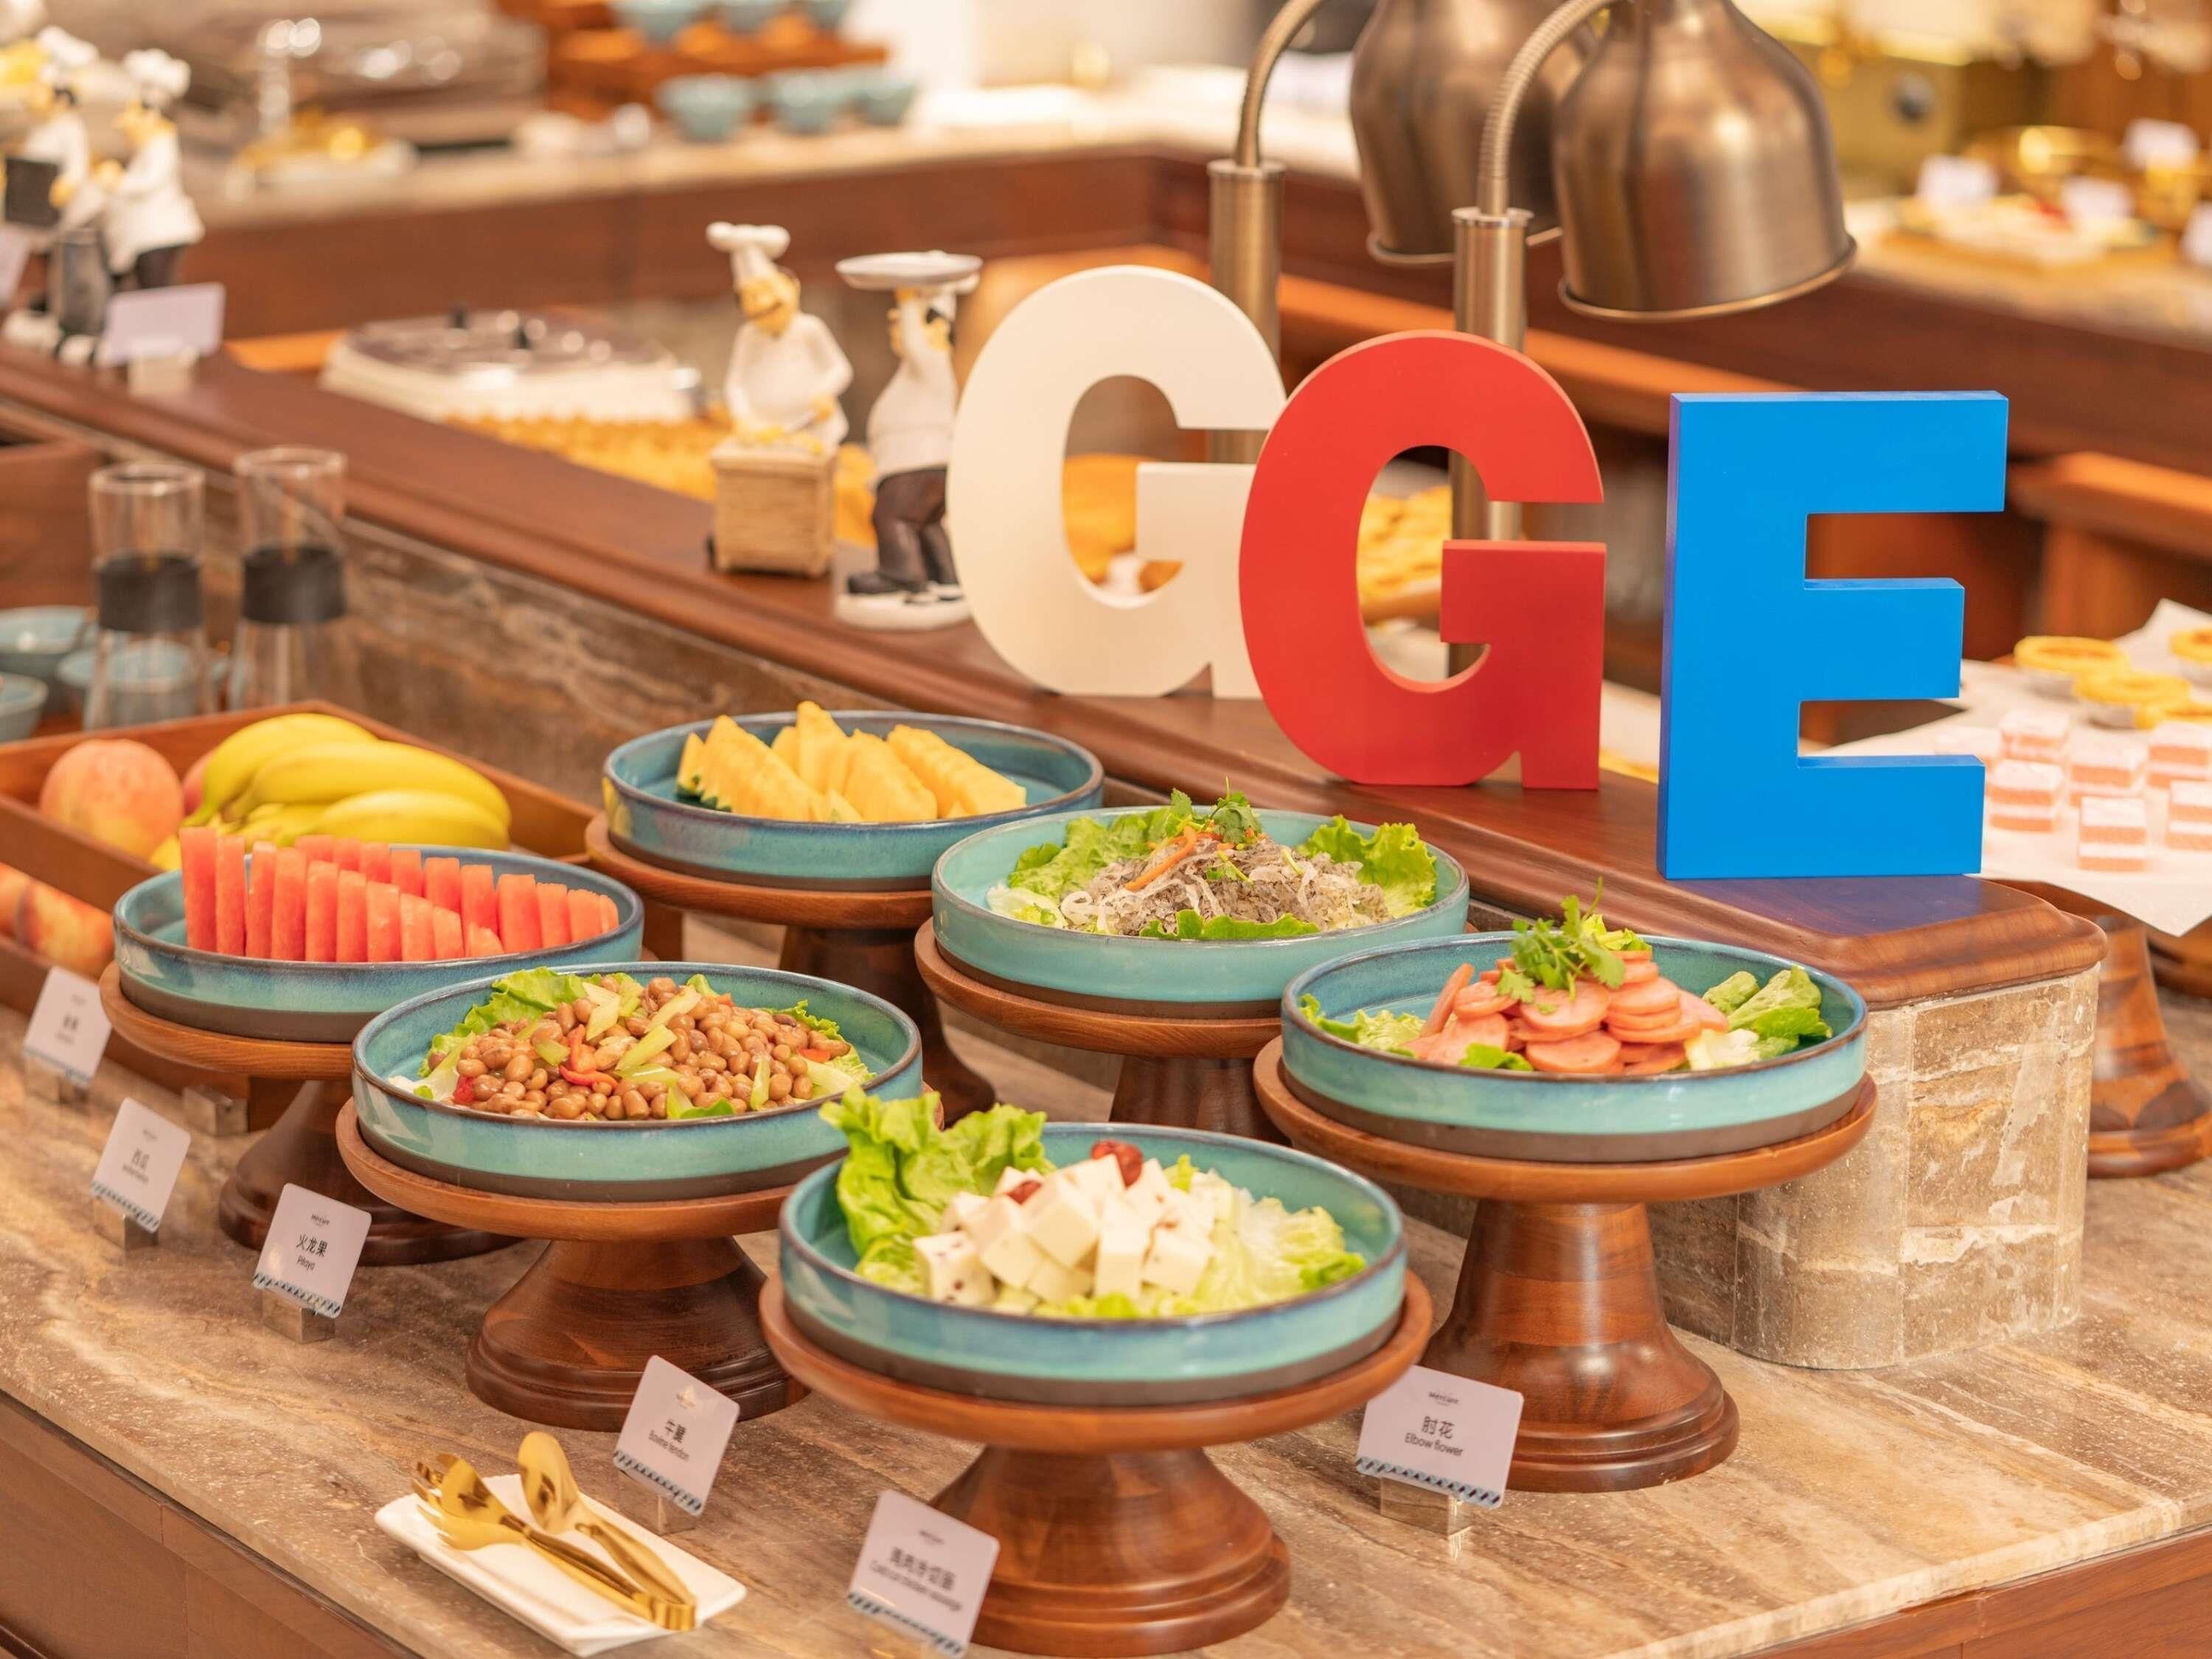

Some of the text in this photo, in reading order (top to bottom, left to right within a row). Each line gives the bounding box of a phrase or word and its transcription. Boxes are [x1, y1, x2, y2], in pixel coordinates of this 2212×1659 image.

[296, 1233, 327, 1256] 火龙果
[1422, 1416, 1454, 1439] 肘花
[1405, 1433, 1464, 1456] Elbow flower
